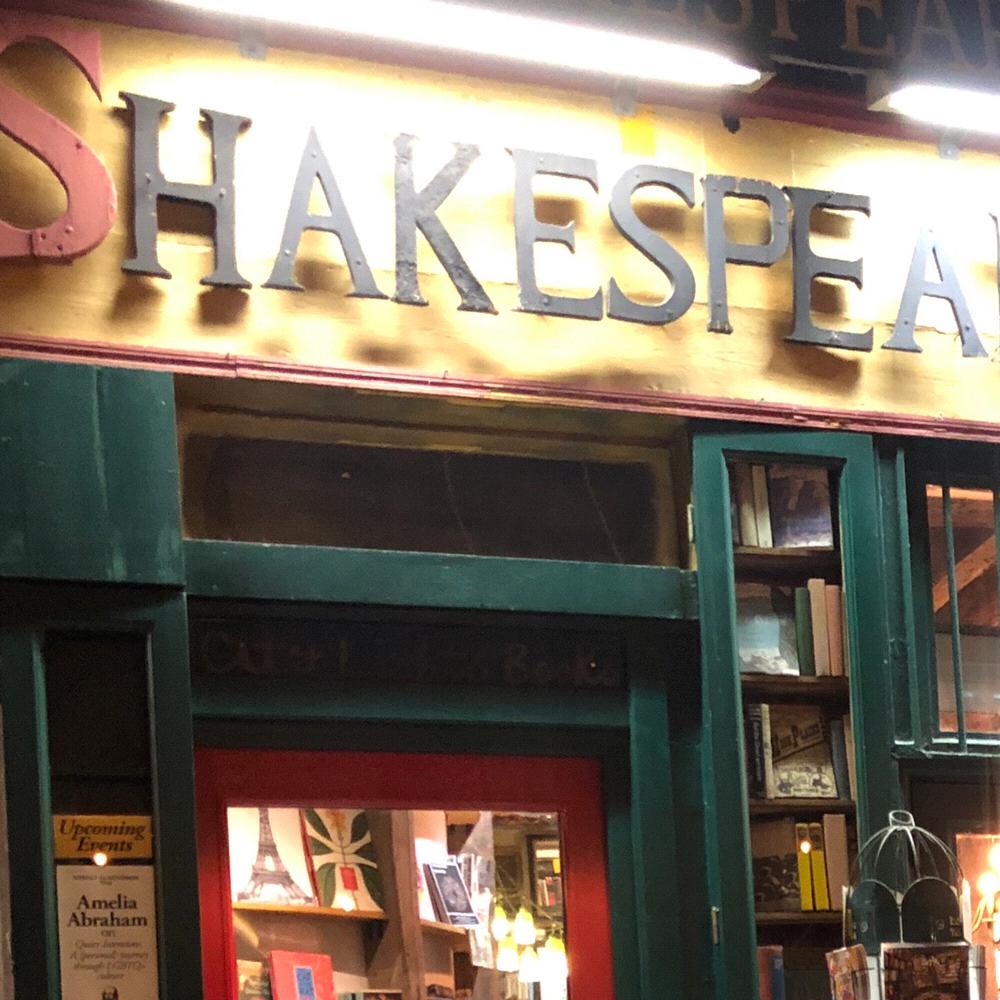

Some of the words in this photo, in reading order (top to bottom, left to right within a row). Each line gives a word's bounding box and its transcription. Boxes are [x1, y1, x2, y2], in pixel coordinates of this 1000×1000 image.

[60, 819, 146, 840] Upcoming
[77, 840, 134, 852] Events
[76, 893, 138, 910] Amelia
[67, 911, 148, 927] Abraham
